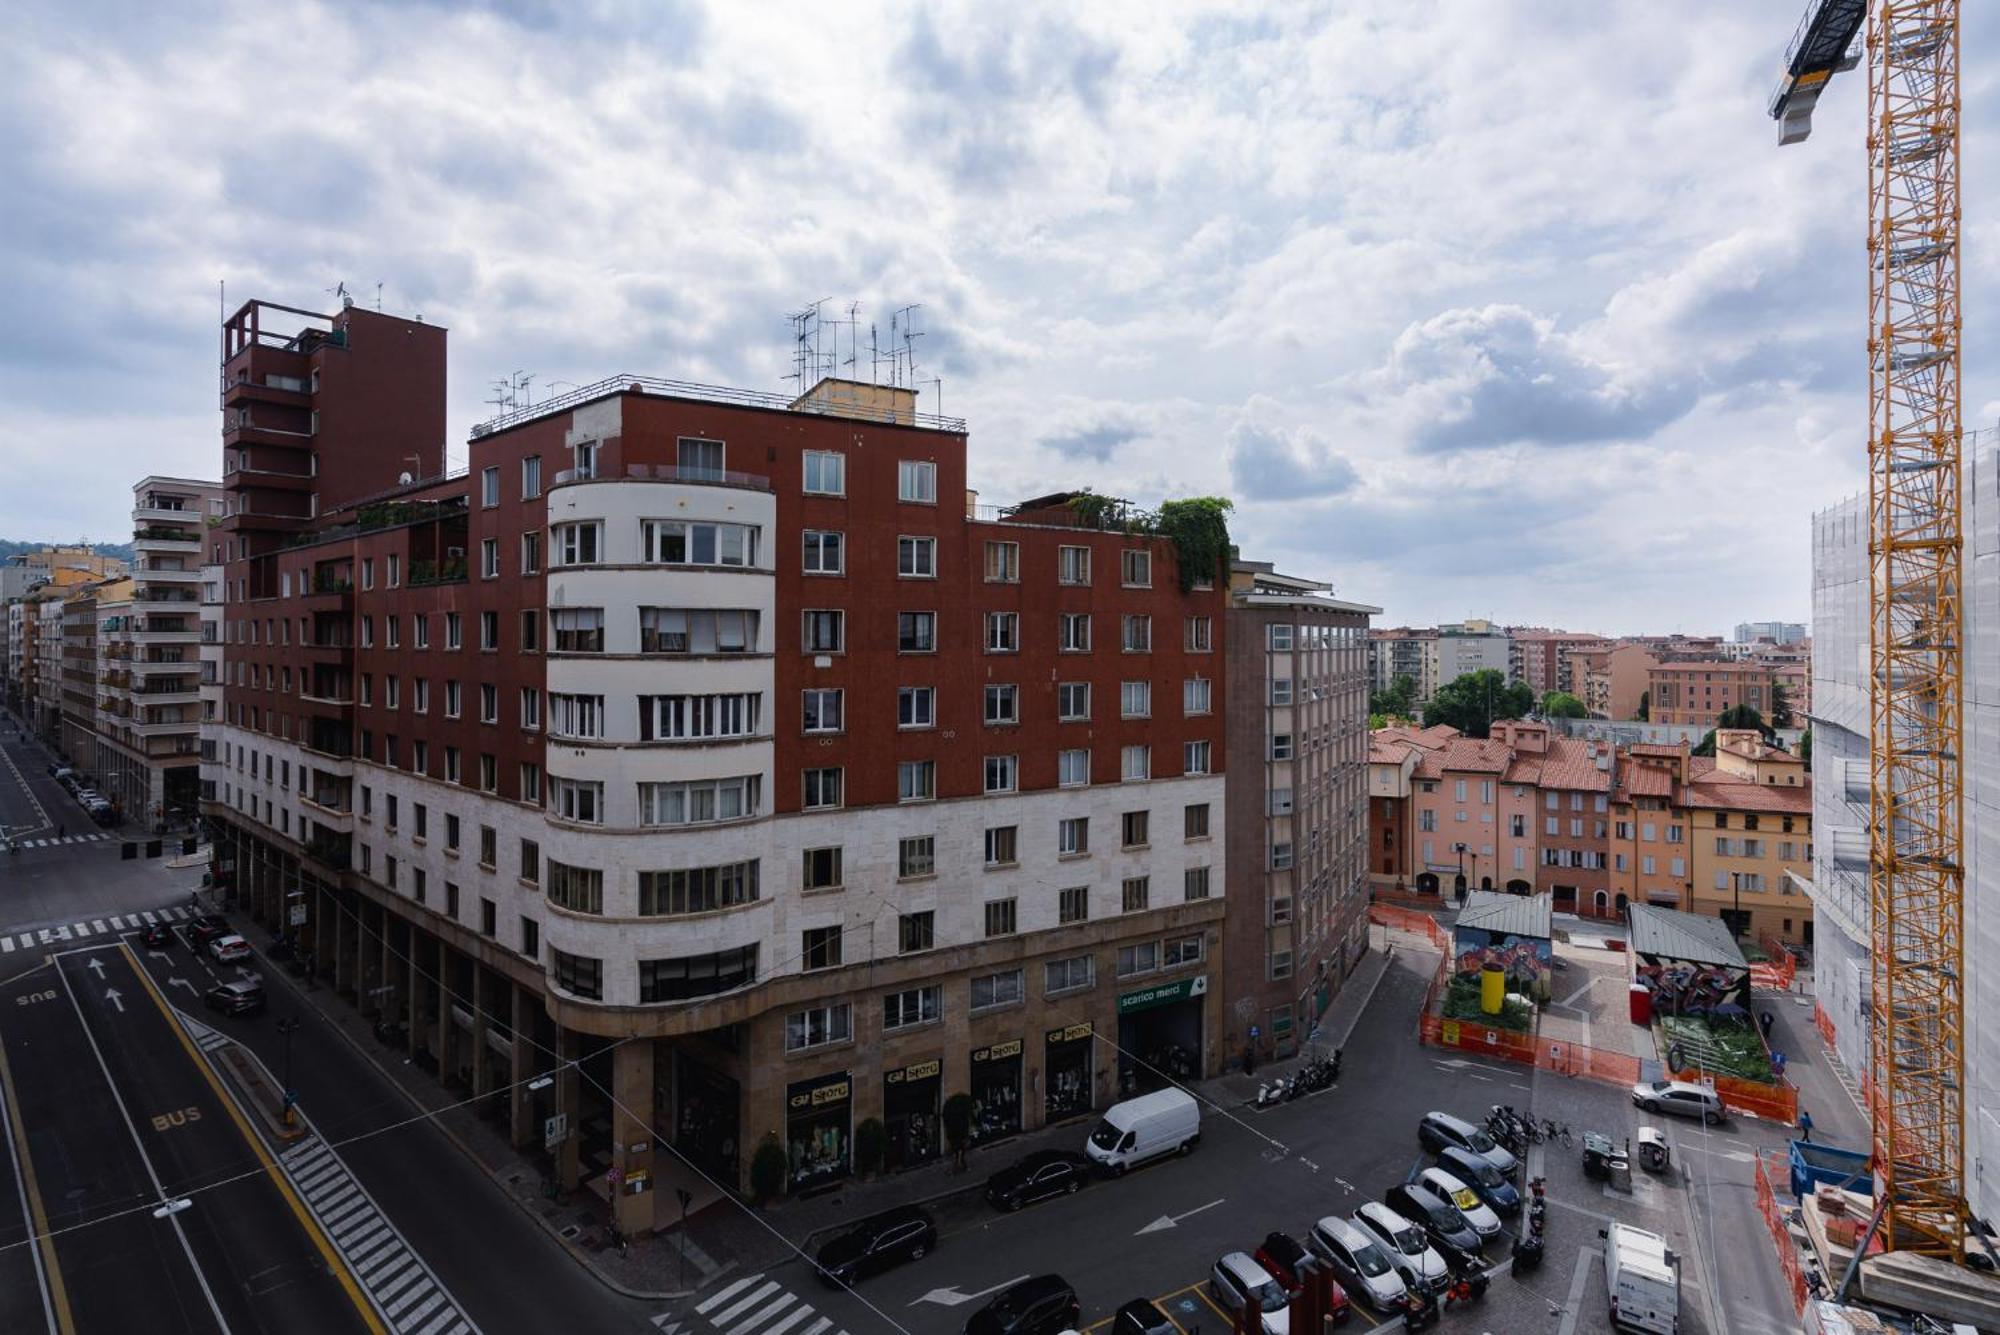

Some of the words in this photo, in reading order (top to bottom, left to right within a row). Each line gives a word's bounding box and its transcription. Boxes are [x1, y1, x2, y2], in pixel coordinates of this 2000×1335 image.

[15, 989, 57, 1006] BUS
[1121, 992, 1154, 1007] scarico
[1156, 984, 1181, 999] merci
[151, 1106, 202, 1132] BUS
